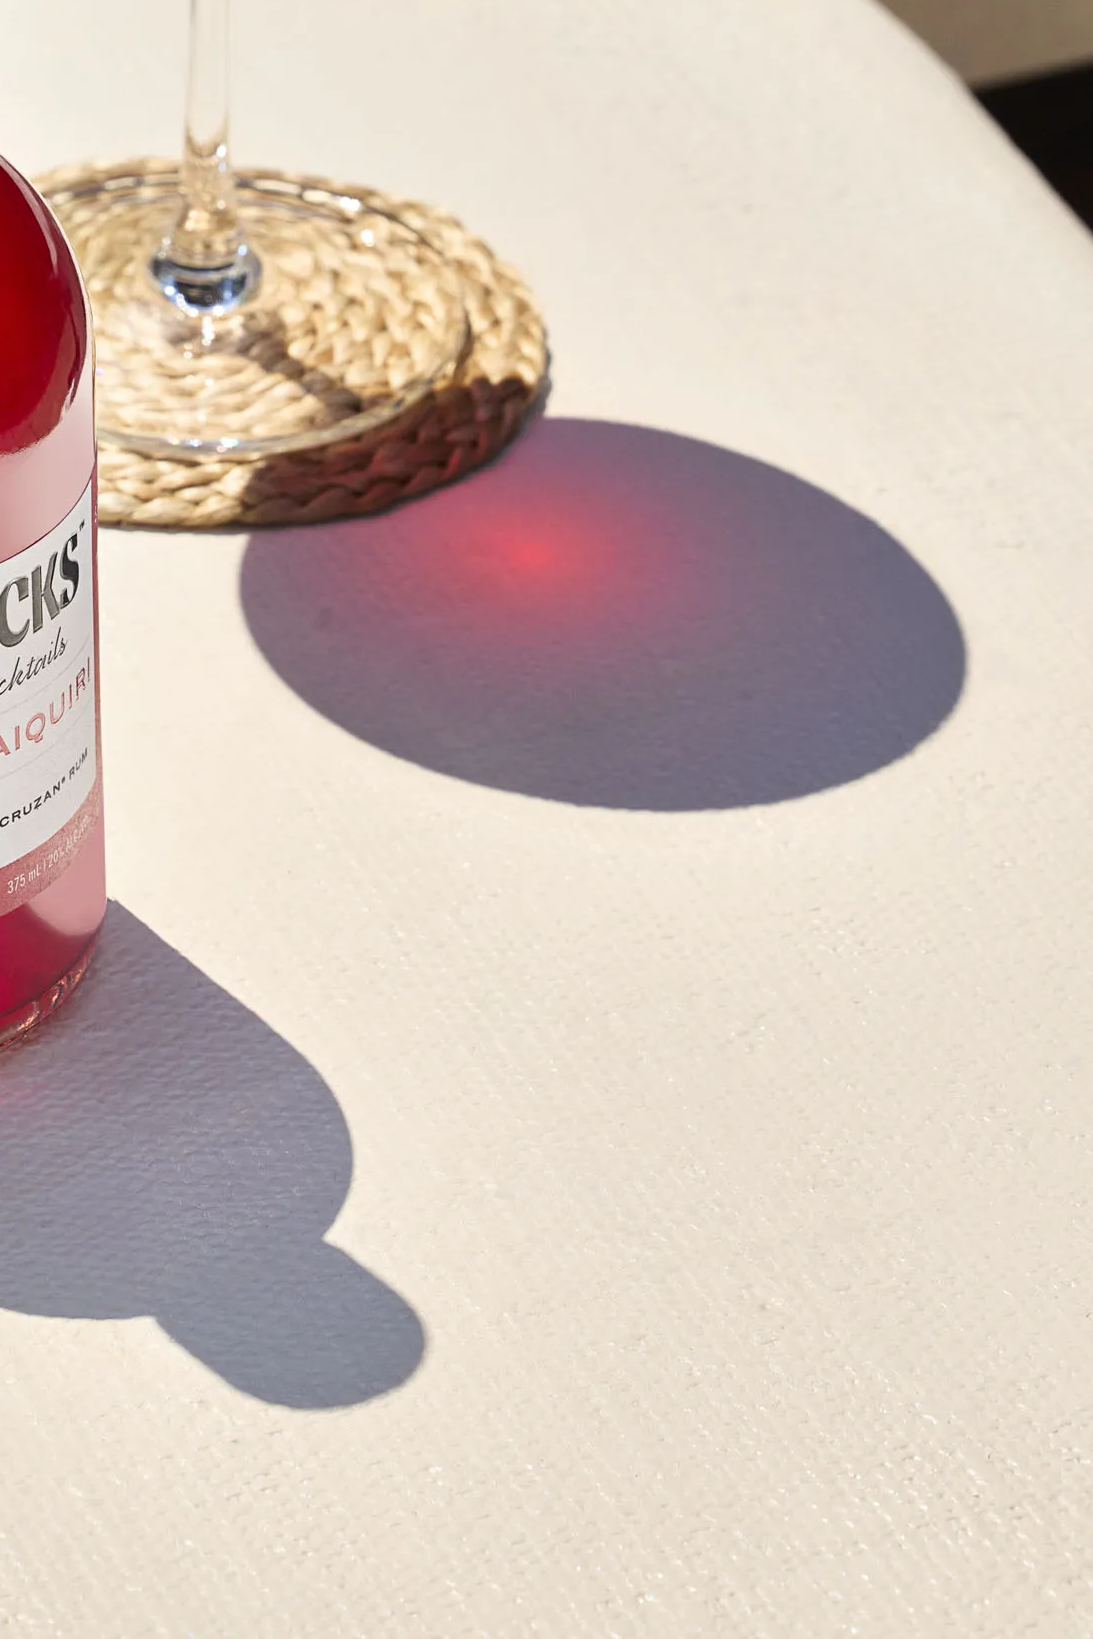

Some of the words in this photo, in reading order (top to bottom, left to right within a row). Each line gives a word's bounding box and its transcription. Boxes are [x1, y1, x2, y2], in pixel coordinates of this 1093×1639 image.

[69, 747, 88, 780] RUM
[7, 872, 26, 894] 375
[28, 863, 41, 881] mL
